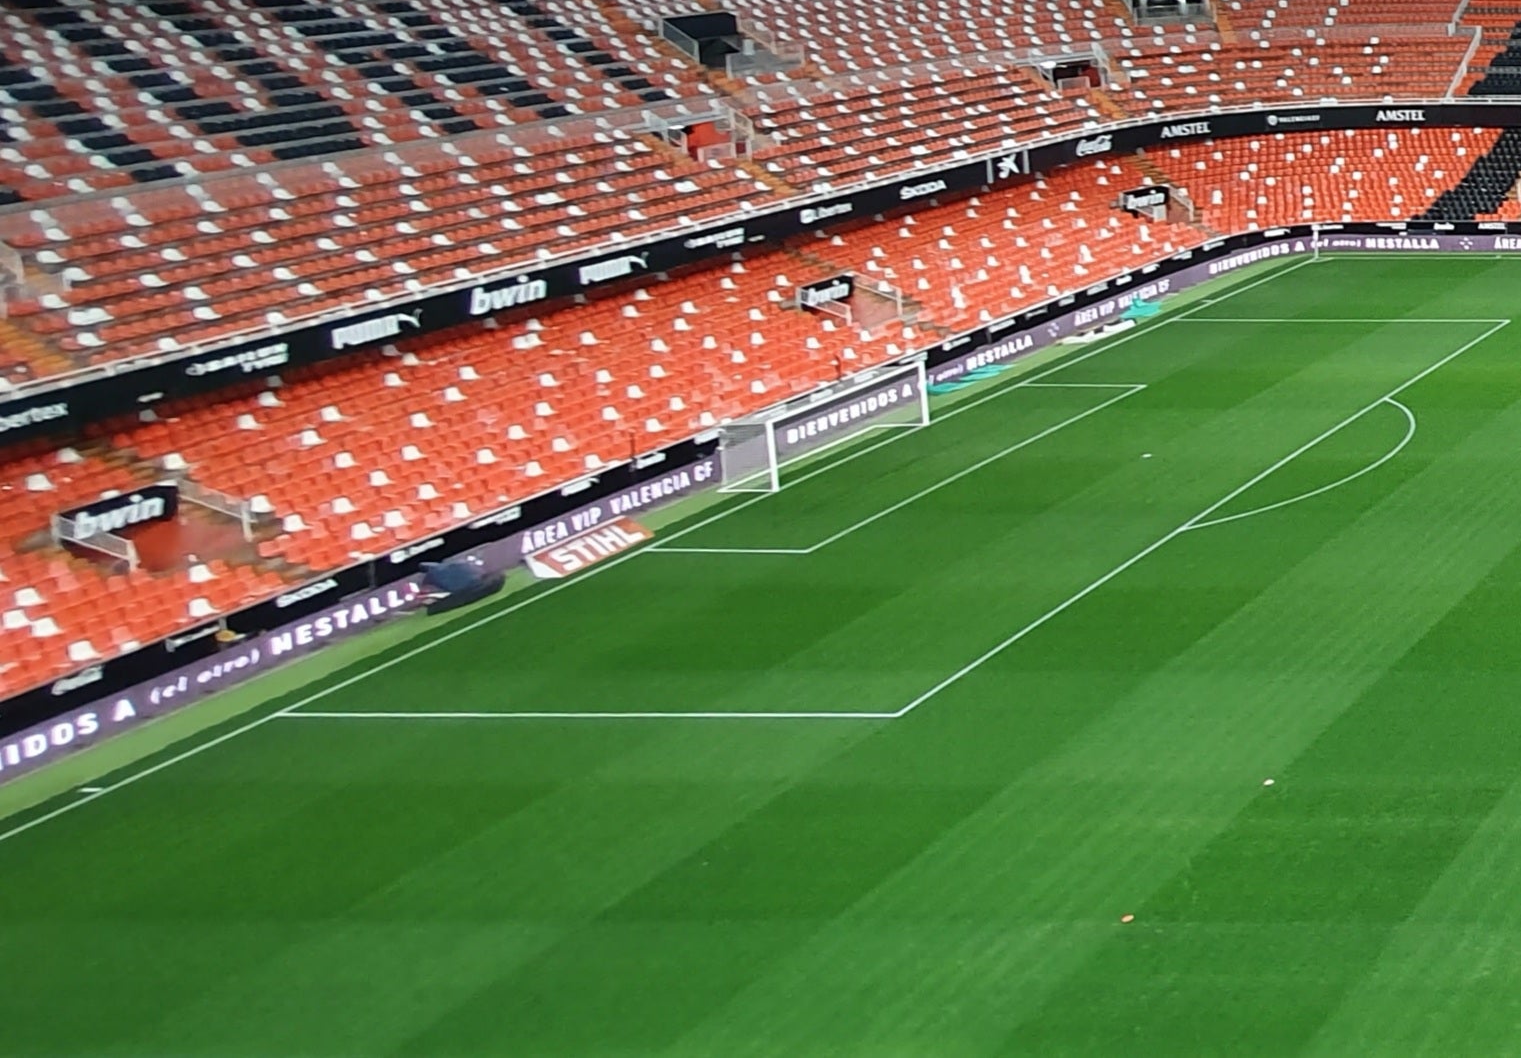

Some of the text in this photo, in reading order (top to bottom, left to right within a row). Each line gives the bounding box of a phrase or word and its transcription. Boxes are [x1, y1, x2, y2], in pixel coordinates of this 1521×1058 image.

[1161, 122, 1212, 139] AMSTEL
[1376, 109, 1426, 121] AMSTEL
[1209, 244, 1290, 274] BIENVENIDOS
[1294, 241, 1305, 252] A
[1365, 238, 1440, 250] MESTALLA
[470, 275, 547, 316] bwin
[1073, 309, 1099, 327] ÁREA
[1099, 300, 1116, 317] VIP
[786, 387, 899, 444] BIENVENIDOS
[901, 382, 913, 398] A
[965, 334, 1034, 371] MESTALLA
[74, 494, 165, 541] bwin
[520, 521, 570, 554] ÁREA
[573, 505, 602, 533] VIP
[609, 467, 692, 516] VALENCIA
[693, 460, 714, 485] CF
[550, 520, 646, 573] STIHL
[0, 708, 100, 773] IDOS
[113, 696, 137, 723] A
[196, 648, 261, 685] otro)
